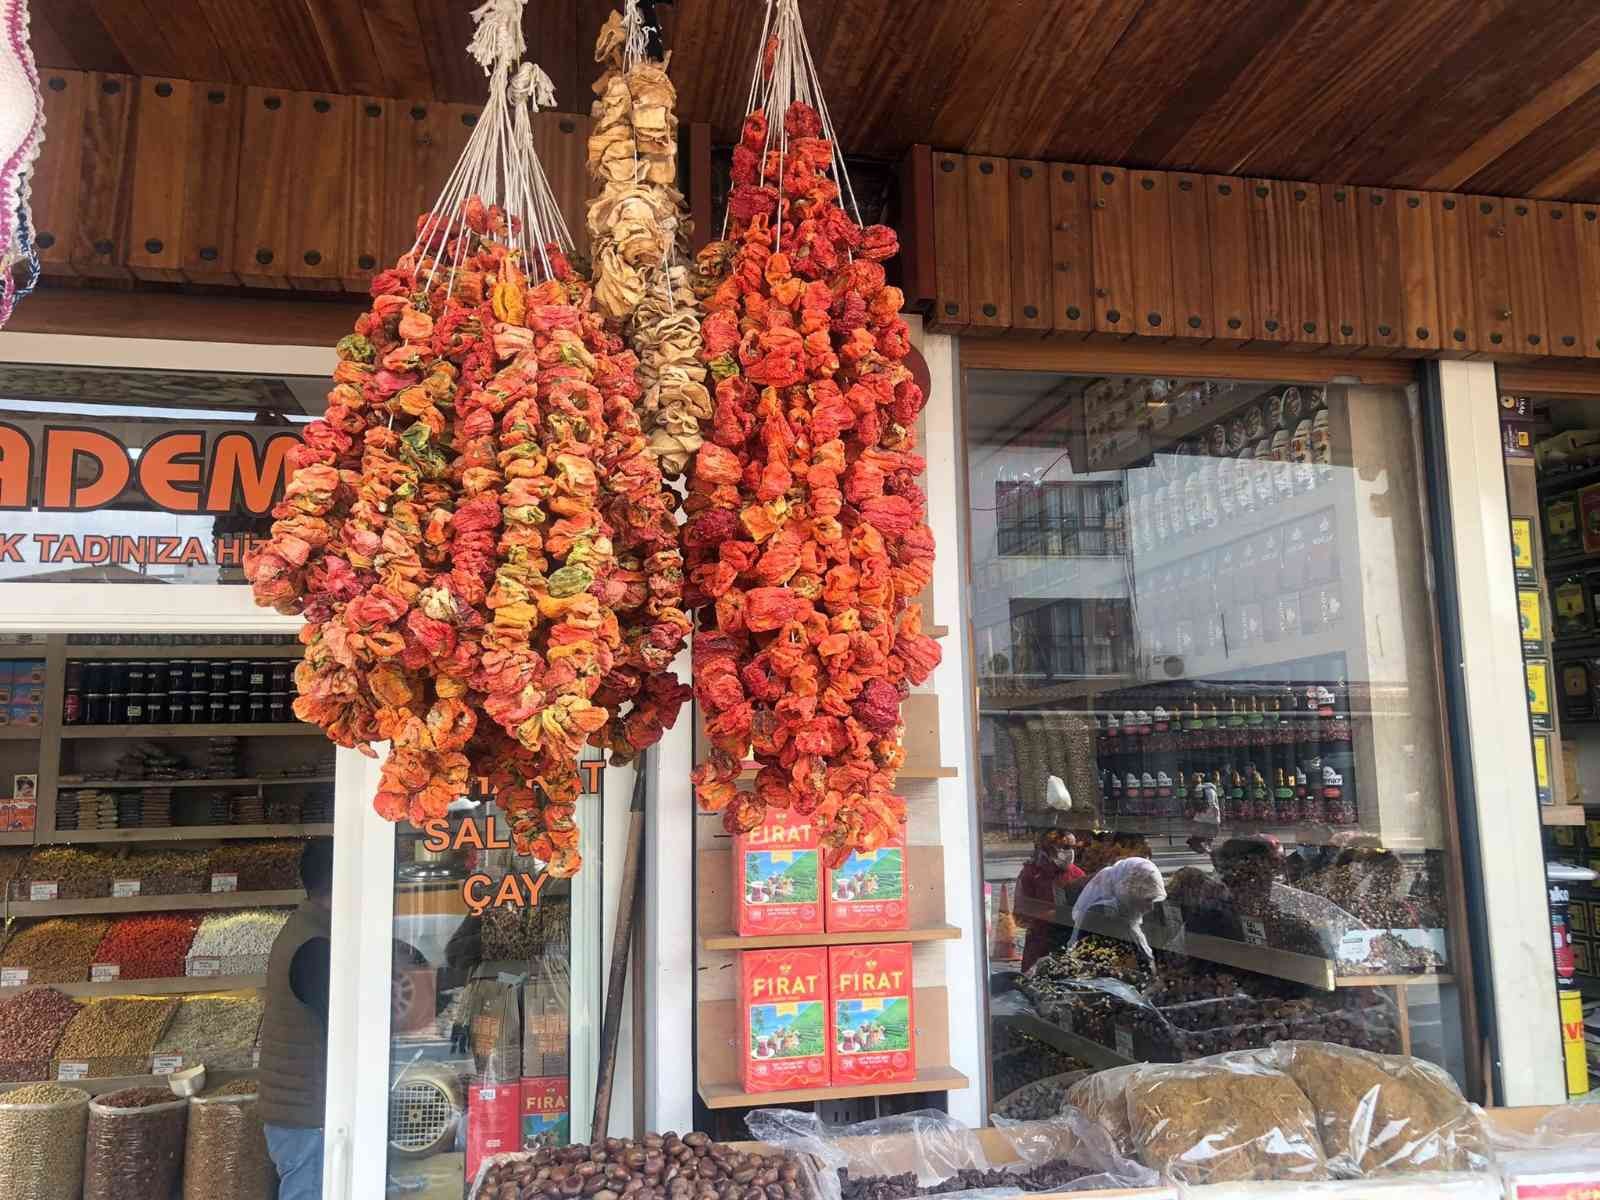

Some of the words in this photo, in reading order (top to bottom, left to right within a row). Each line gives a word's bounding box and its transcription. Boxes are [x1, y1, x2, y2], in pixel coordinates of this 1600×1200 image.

[33, 534, 208, 565] TADINIZA
[749, 824, 811, 843] FIRAT
[463, 873, 549, 916] ÇAY
[752, 976, 817, 997] FIRAT
[839, 972, 903, 992] FIRAT
[527, 1095, 568, 1110] FIRA
